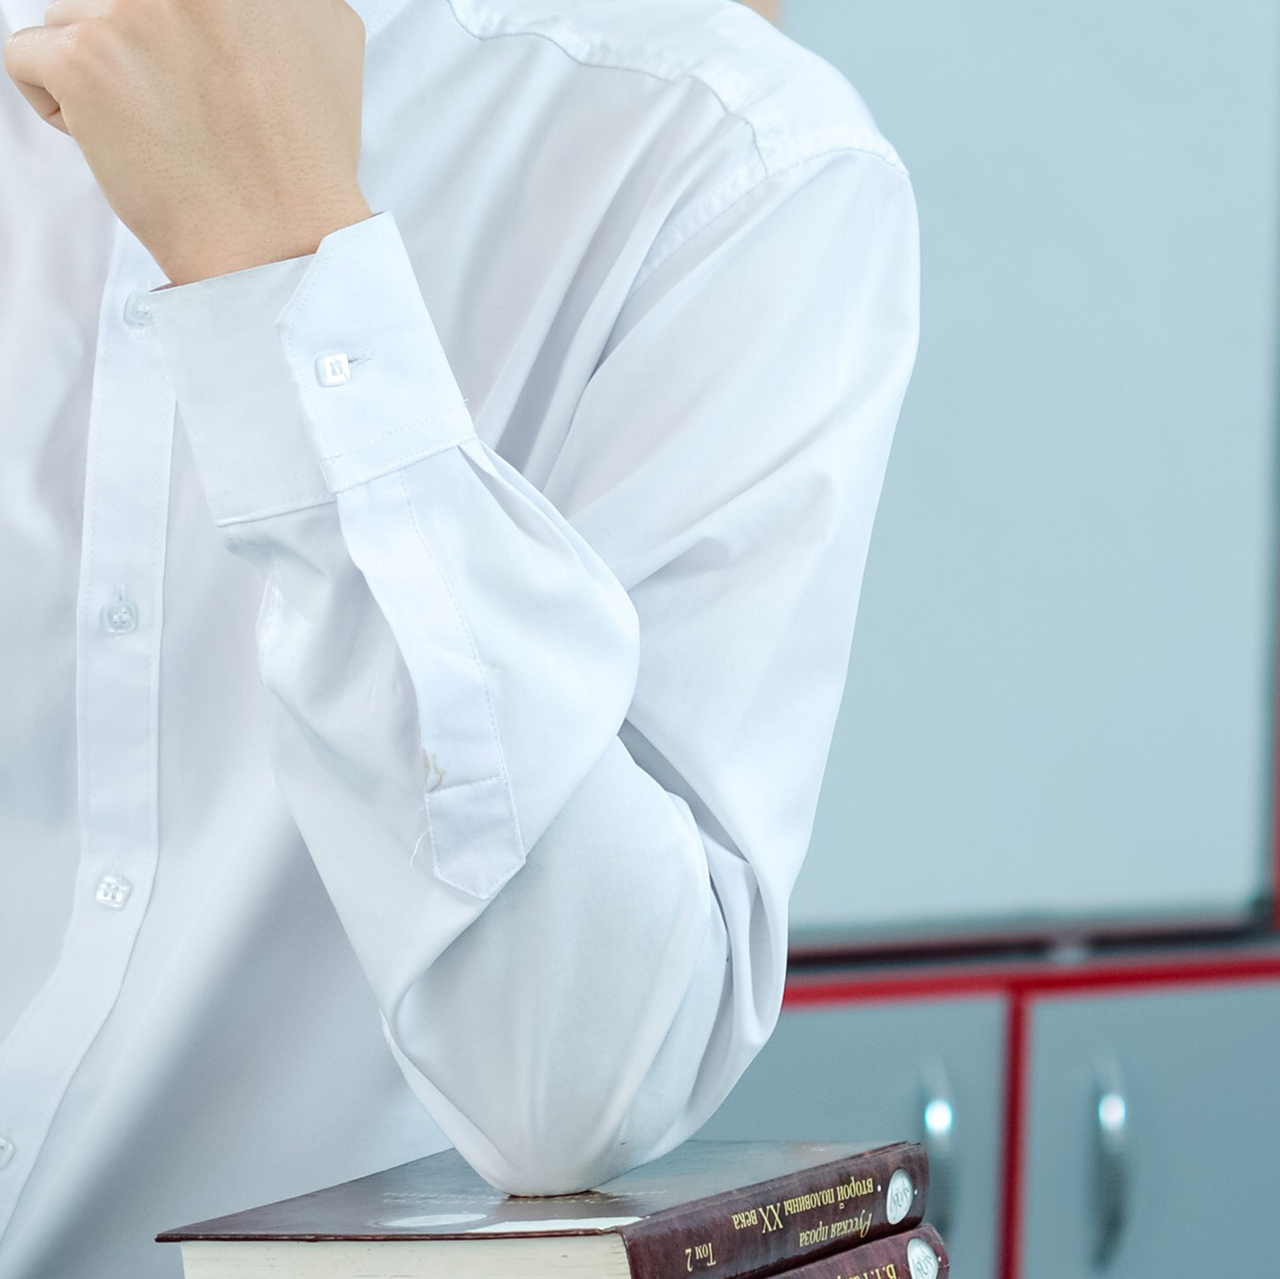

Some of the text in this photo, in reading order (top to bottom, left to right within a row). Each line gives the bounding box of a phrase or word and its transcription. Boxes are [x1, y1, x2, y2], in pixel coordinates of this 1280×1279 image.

[784, 1190, 836, 1217] половины
[836, 1177, 874, 1210] второй
[731, 1210, 759, 1230] века
[798, 1209, 874, 1248] Русская проза
[685, 1241, 717, 1272] Том 2
